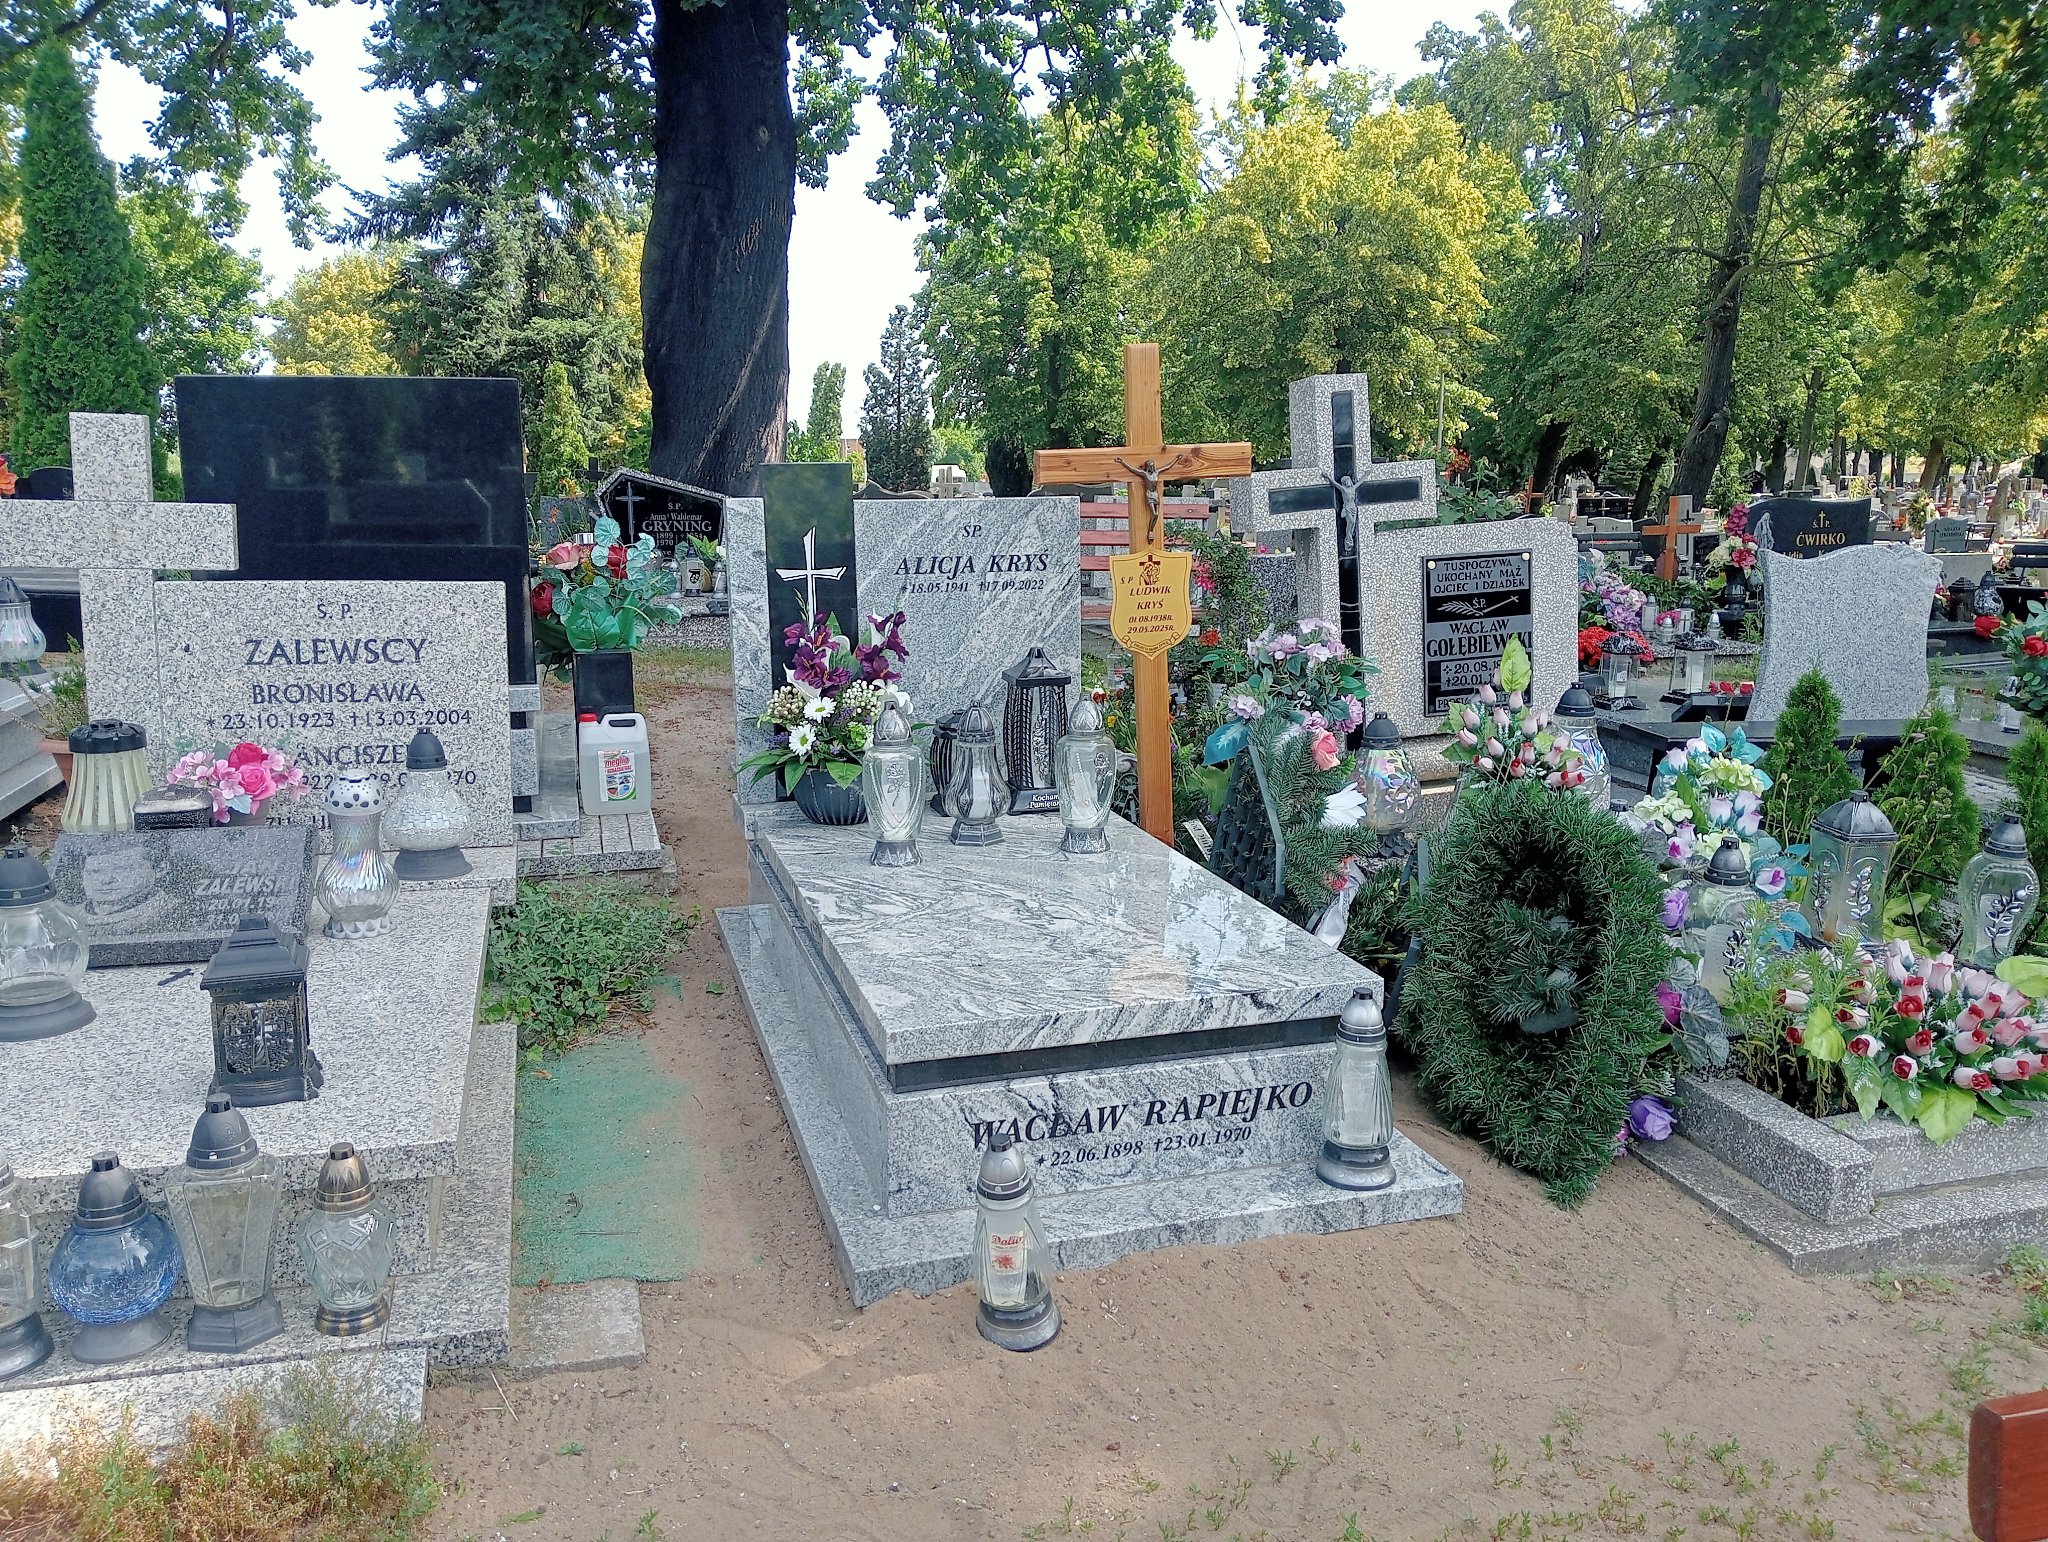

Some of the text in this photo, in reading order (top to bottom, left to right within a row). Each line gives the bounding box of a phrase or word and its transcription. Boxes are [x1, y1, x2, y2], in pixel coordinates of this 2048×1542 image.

[642, 520, 712, 532] GRYNING
[894, 548, 1049, 580] ALICJA KRYŚ
[1437, 565, 1522, 583] UKOCHANY MĄŻ
[1129, 585, 1172, 597] LUDWIK
[1434, 582, 1469, 594] OJCIEC
[1483, 577, 1525, 590] DZIADEK
[1136, 599, 1165, 610] KRYŚ
[1448, 619, 1510, 635] WACŁAW
[244, 638, 427, 666] ZALEWSCY
[1426, 631, 1532, 657] GOŁĘBIEWKI
[251, 683, 425, 705] BRONISŁAWA
[973, 1081, 1314, 1149] WACŁAW RAPIEJKO
